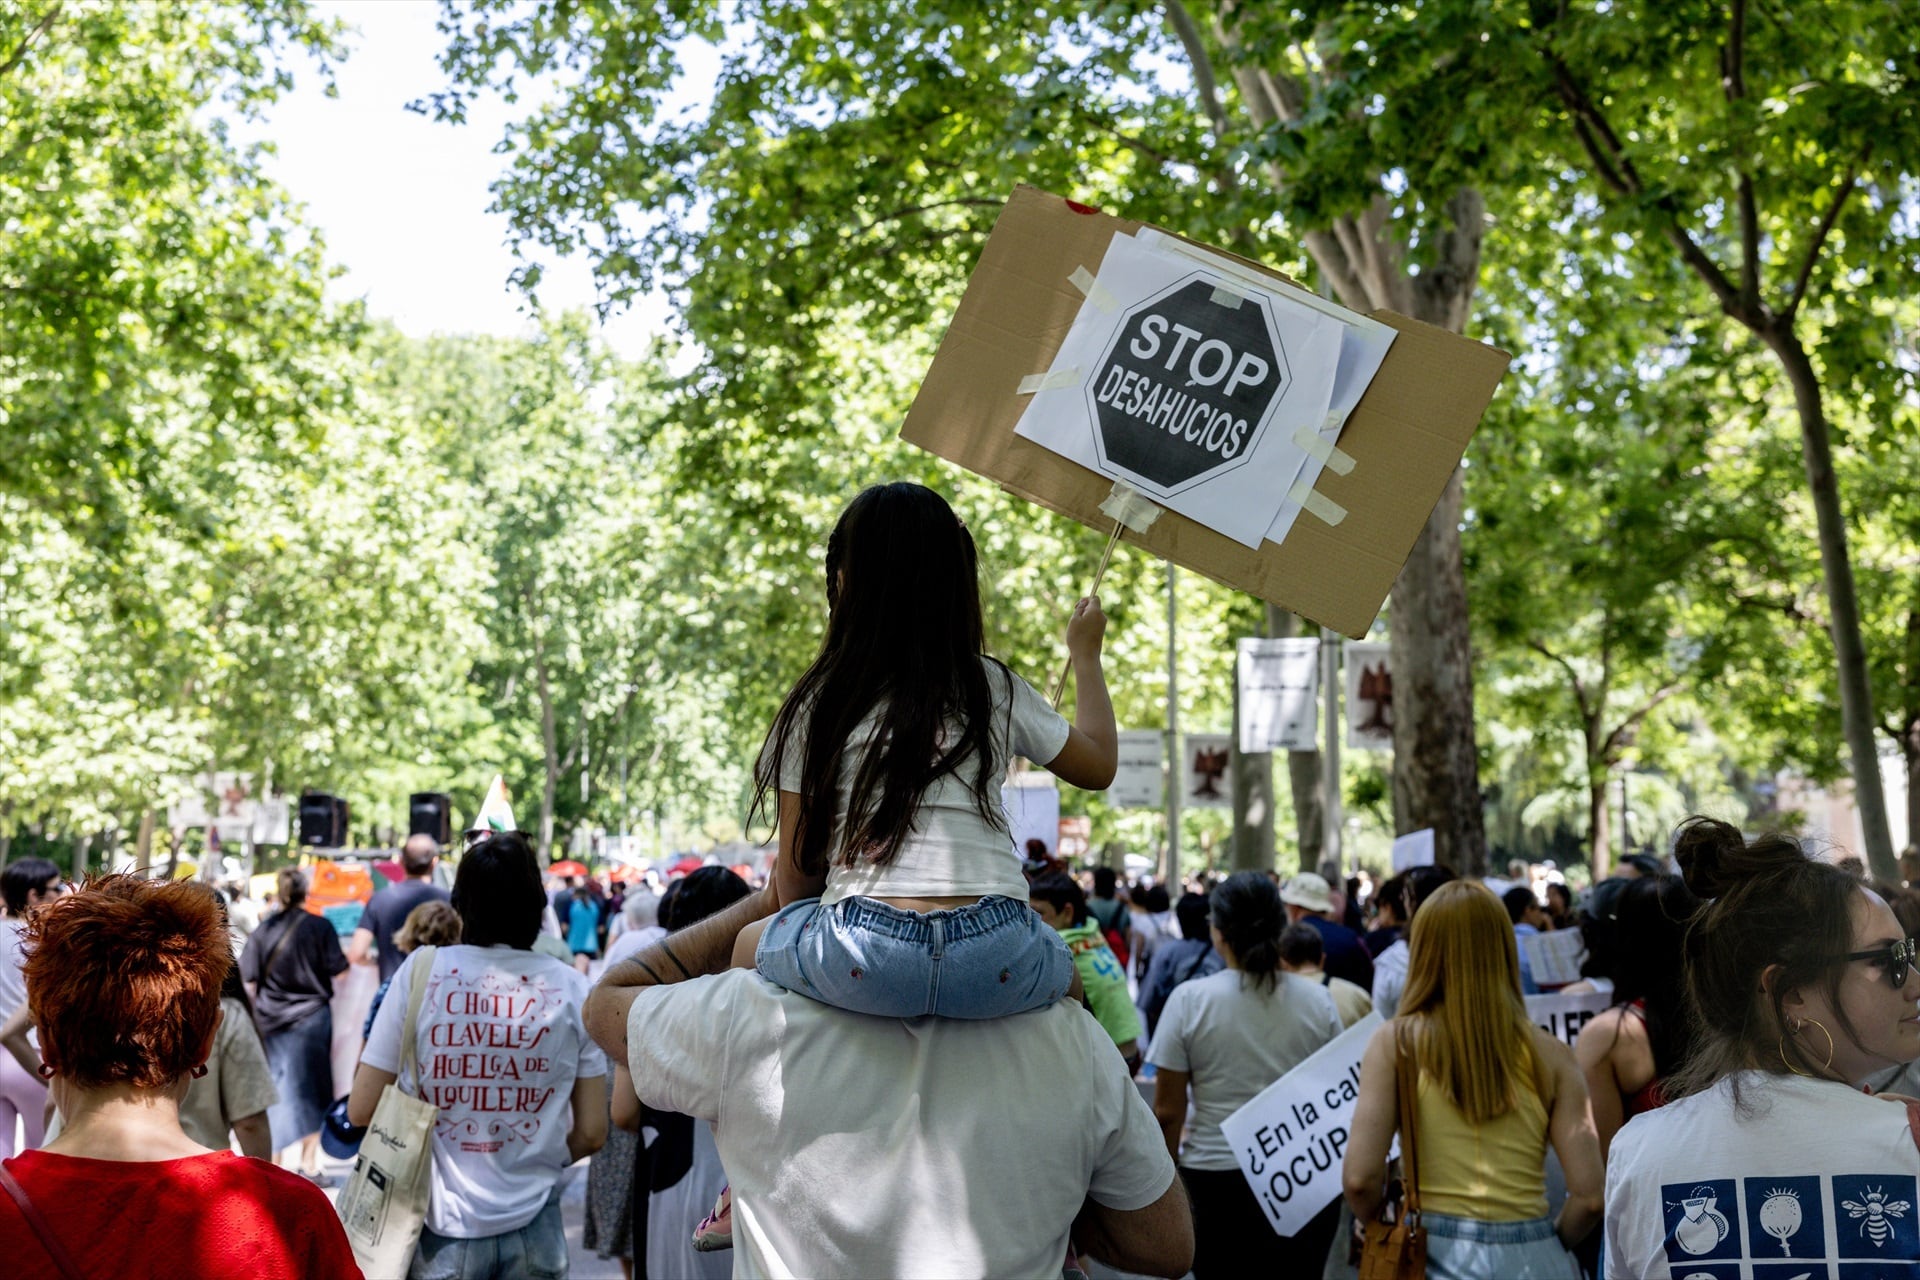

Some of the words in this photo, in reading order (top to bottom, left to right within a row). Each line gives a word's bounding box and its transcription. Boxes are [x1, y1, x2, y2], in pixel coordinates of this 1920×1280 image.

[1130, 314, 1269, 397] STOP
[1098, 364, 1248, 458] DESAHUCIOS
[431, 1022, 549, 1049] CLAVELES
[433, 1053, 521, 1080] HUELGA
[525, 1057, 549, 1072] DE
[1247, 1122, 1293, 1175] ¿En
[1291, 1102, 1320, 1130] la
[1324, 1061, 1361, 1110] cal
